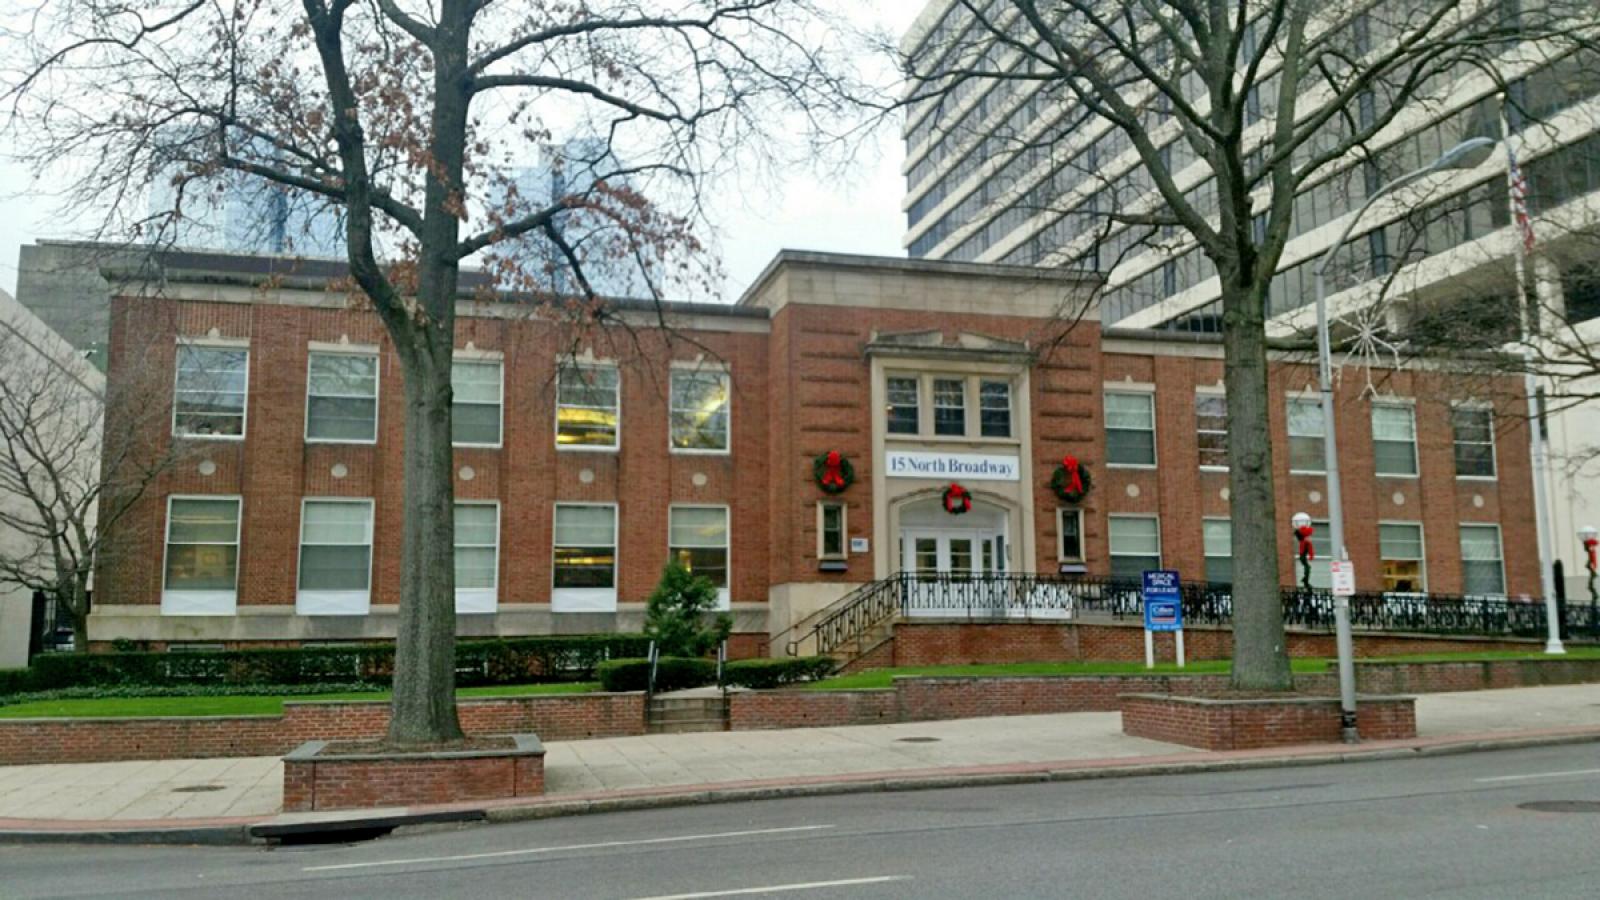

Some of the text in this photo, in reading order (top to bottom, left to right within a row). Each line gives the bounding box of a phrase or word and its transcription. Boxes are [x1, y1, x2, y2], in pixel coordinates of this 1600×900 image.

[891, 457, 1013, 477] 15 North Broadway
